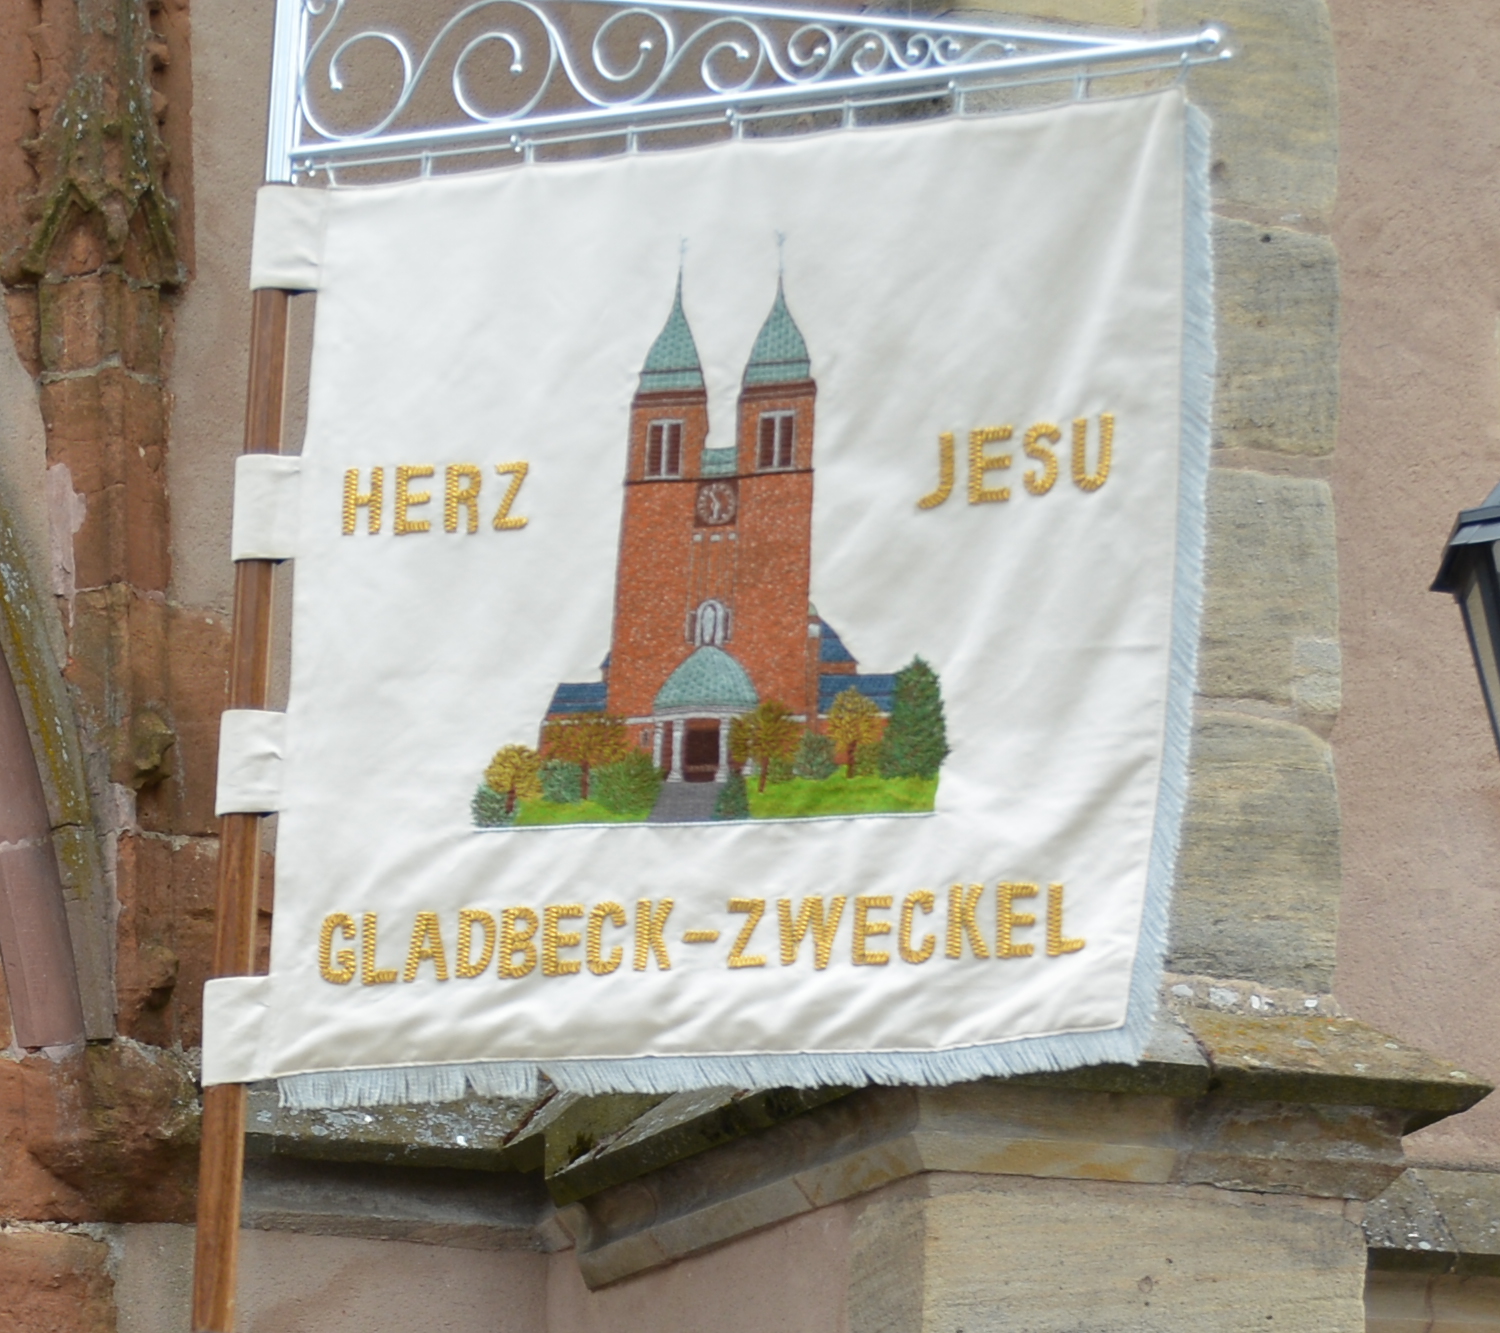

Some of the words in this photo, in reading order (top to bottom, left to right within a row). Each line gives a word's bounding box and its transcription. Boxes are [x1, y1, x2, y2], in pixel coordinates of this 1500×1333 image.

[342, 461, 529, 536] HERZ
[917, 412, 1115, 510] JESU
[317, 883, 1085, 986] GLADBECK-ZWECKEL
